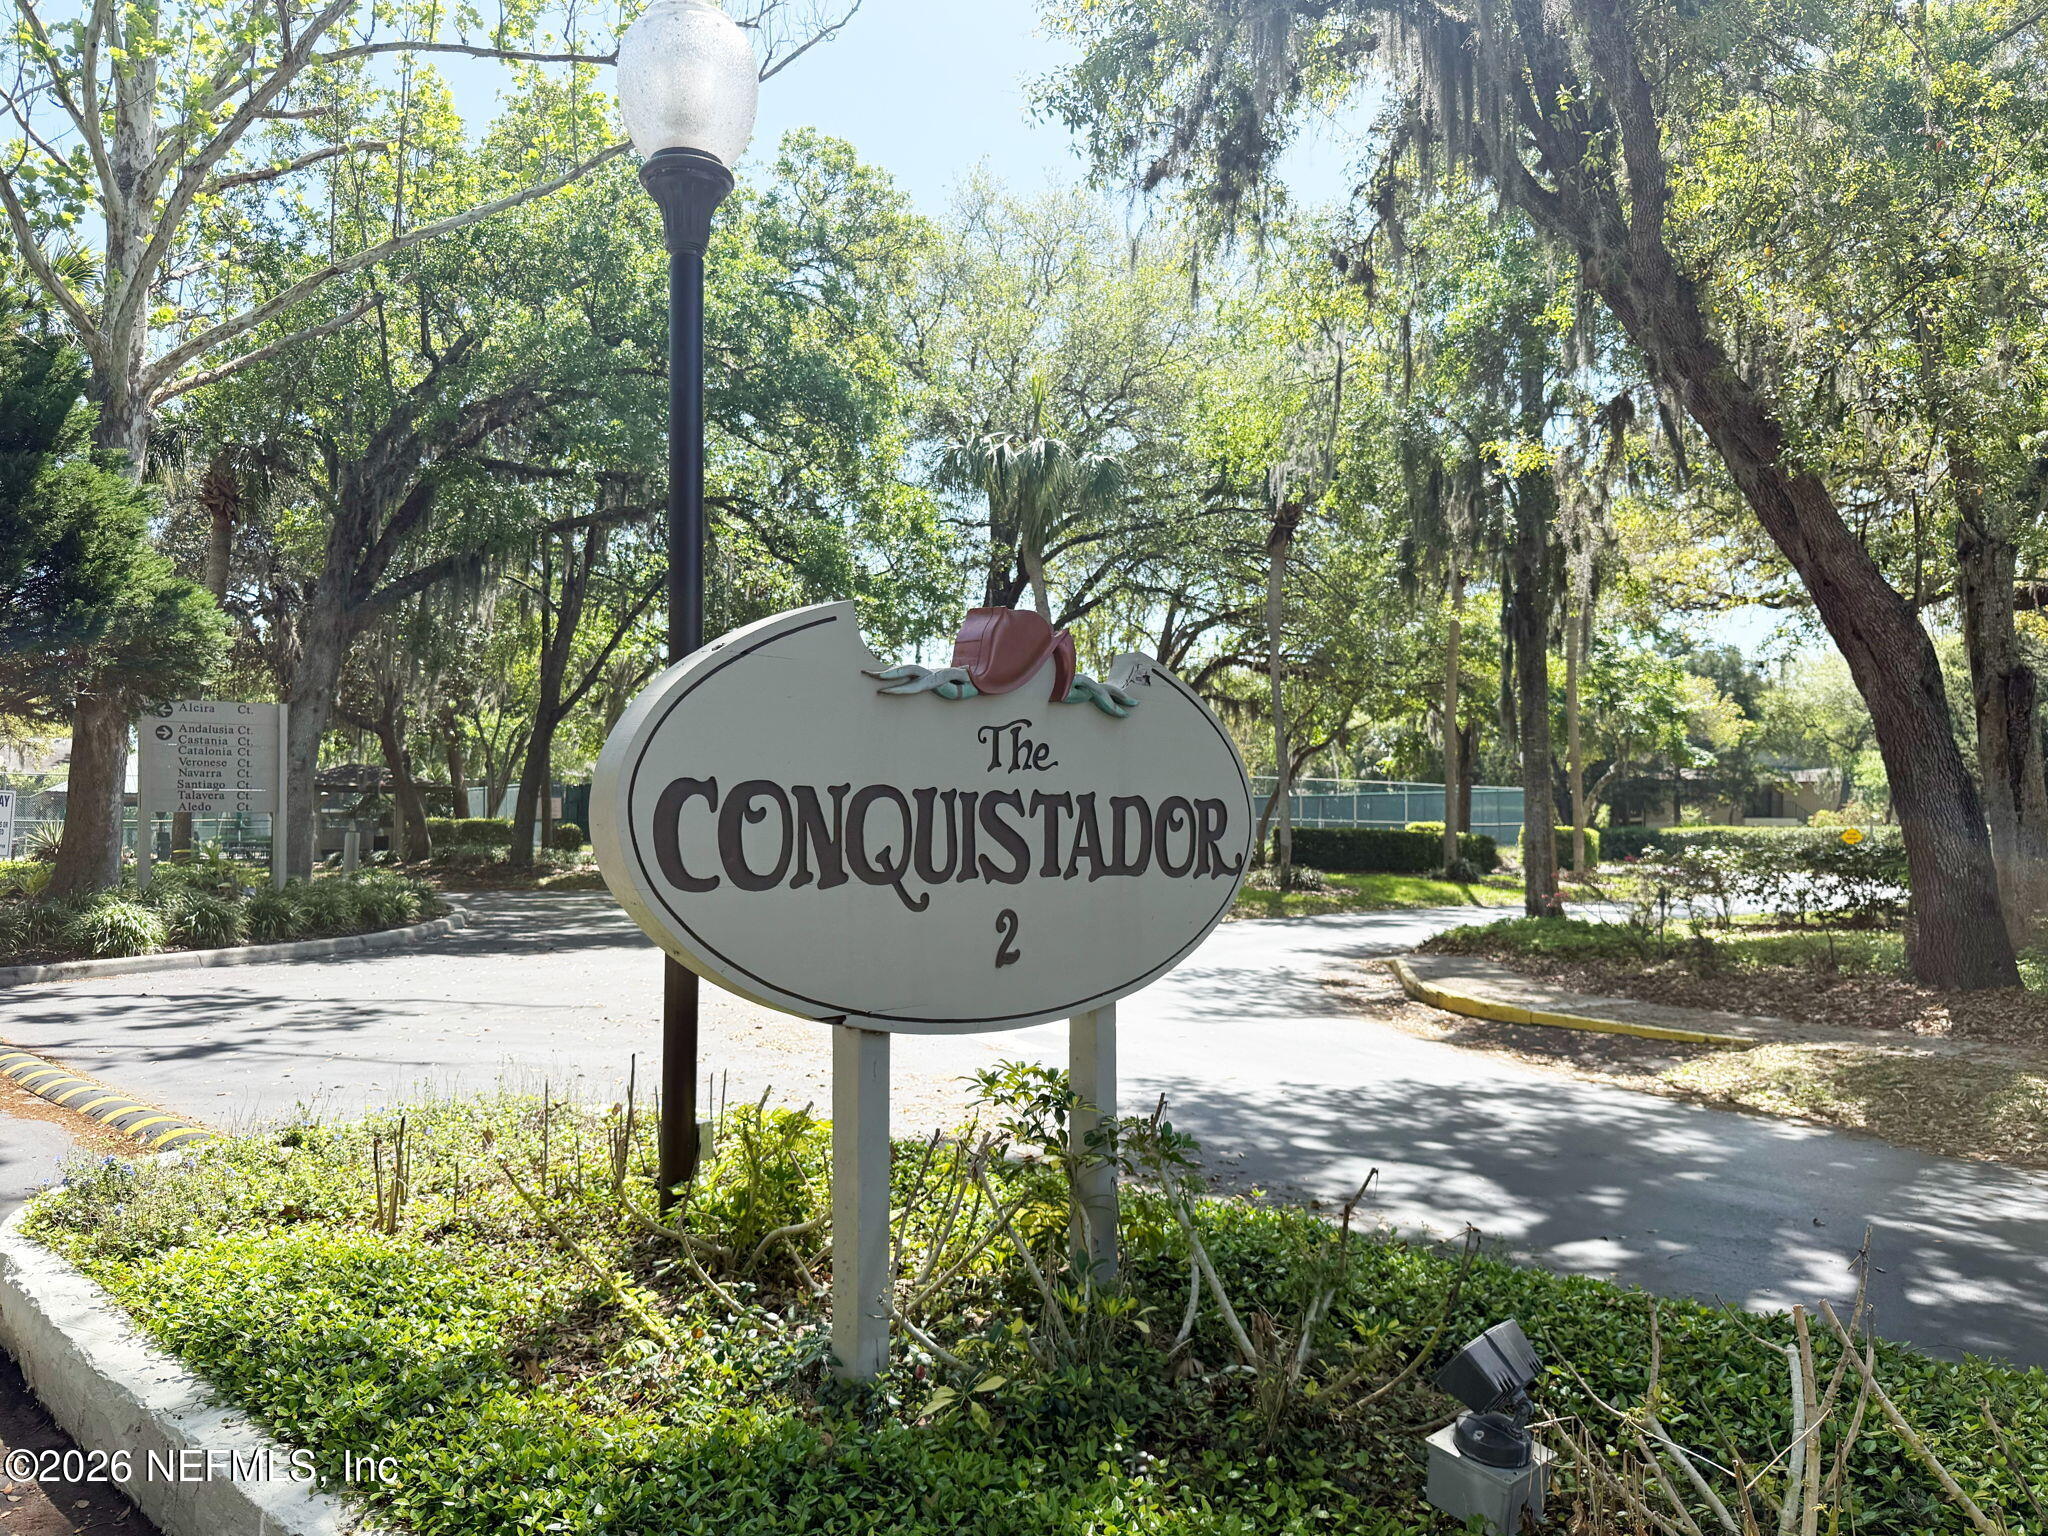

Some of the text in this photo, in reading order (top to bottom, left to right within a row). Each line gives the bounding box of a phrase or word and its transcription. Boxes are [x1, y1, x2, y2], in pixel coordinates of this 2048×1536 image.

[178, 702, 254, 715] Alcira Ct.
[178, 723, 254, 735] Andalusia Ct.
[178, 734, 254, 746] Castania Ct.
[977, 718, 1059, 774] The
[177, 745, 254, 757] Catalonia Ct.
[178, 756, 253, 768] Veronese Ct.
[178, 768, 253, 779] Navarra Ct.
[176, 779, 253, 792] Santiago Ct.
[177, 790, 253, 800] Talavera Ct.
[177, 801, 253, 812] Aledo Ct.
[652, 775, 1243, 912] CONQUISTADOR
[995, 907, 1021, 969] 2
